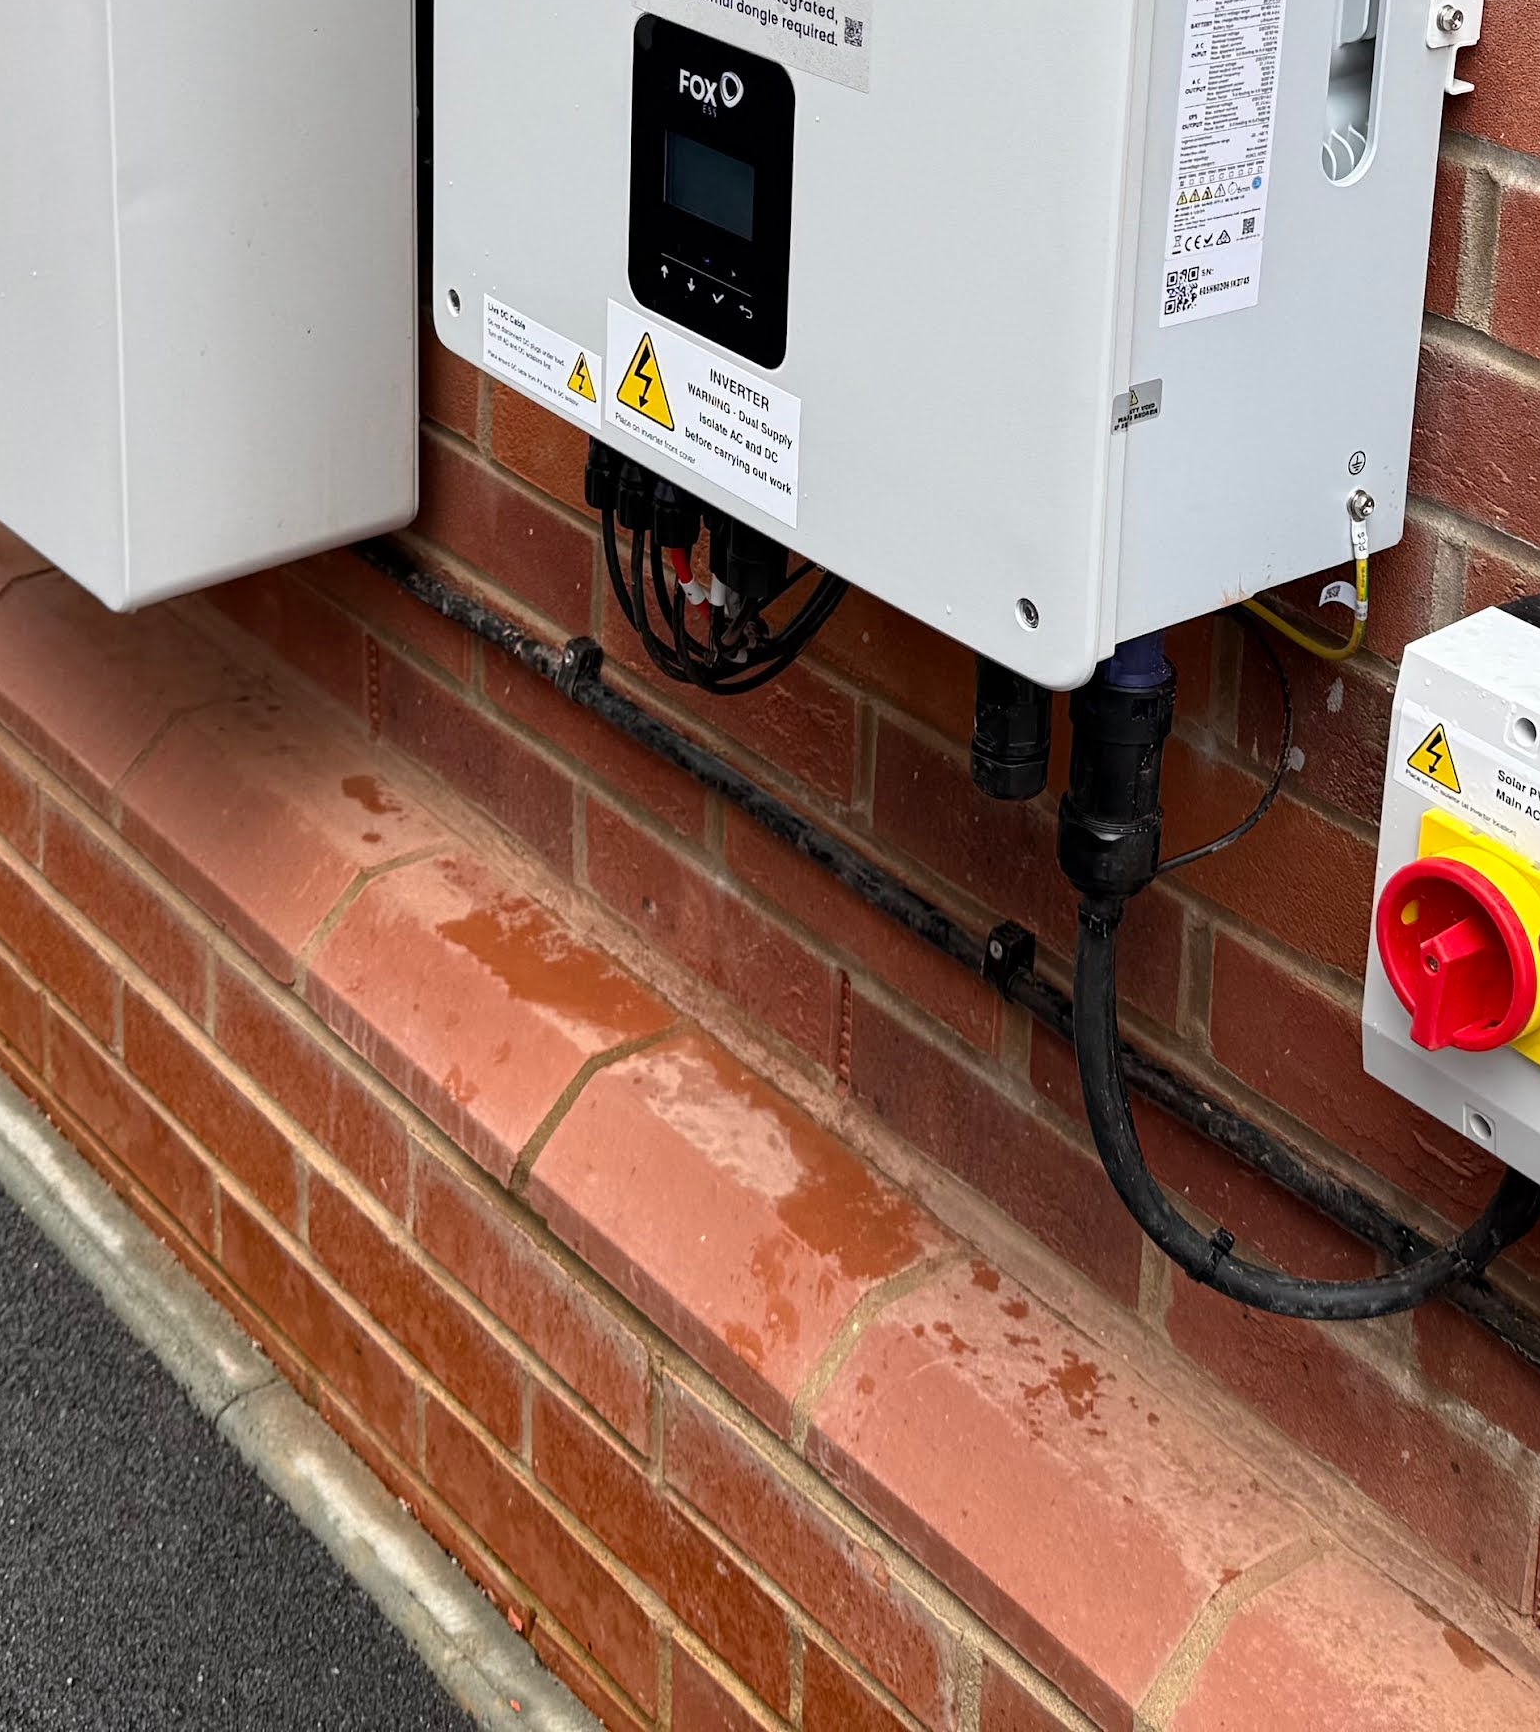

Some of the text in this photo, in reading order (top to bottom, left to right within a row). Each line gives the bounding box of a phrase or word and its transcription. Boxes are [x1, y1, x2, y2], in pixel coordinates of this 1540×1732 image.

[736, 0, 778, 26] dongle
[782, 16, 838, 47] required.
[679, 68, 718, 108] FOX
[702, 104, 717, 118] ESS
[709, 368, 770, 412] INVERTER
[687, 382, 731, 415] WARNING
[738, 410, 759, 430] Dual
[761, 422, 793, 450] Supply
[685, 426, 792, 496] before carrying out work
[730, 430, 743, 445] AC
[745, 438, 762, 456] and
[764, 448, 779, 463] DC
[1429, 782, 1439, 793] AC
[1497, 769, 1527, 792] Solar
[1495, 788, 1522, 811] Main
[1525, 805, 1540, 821] AC
